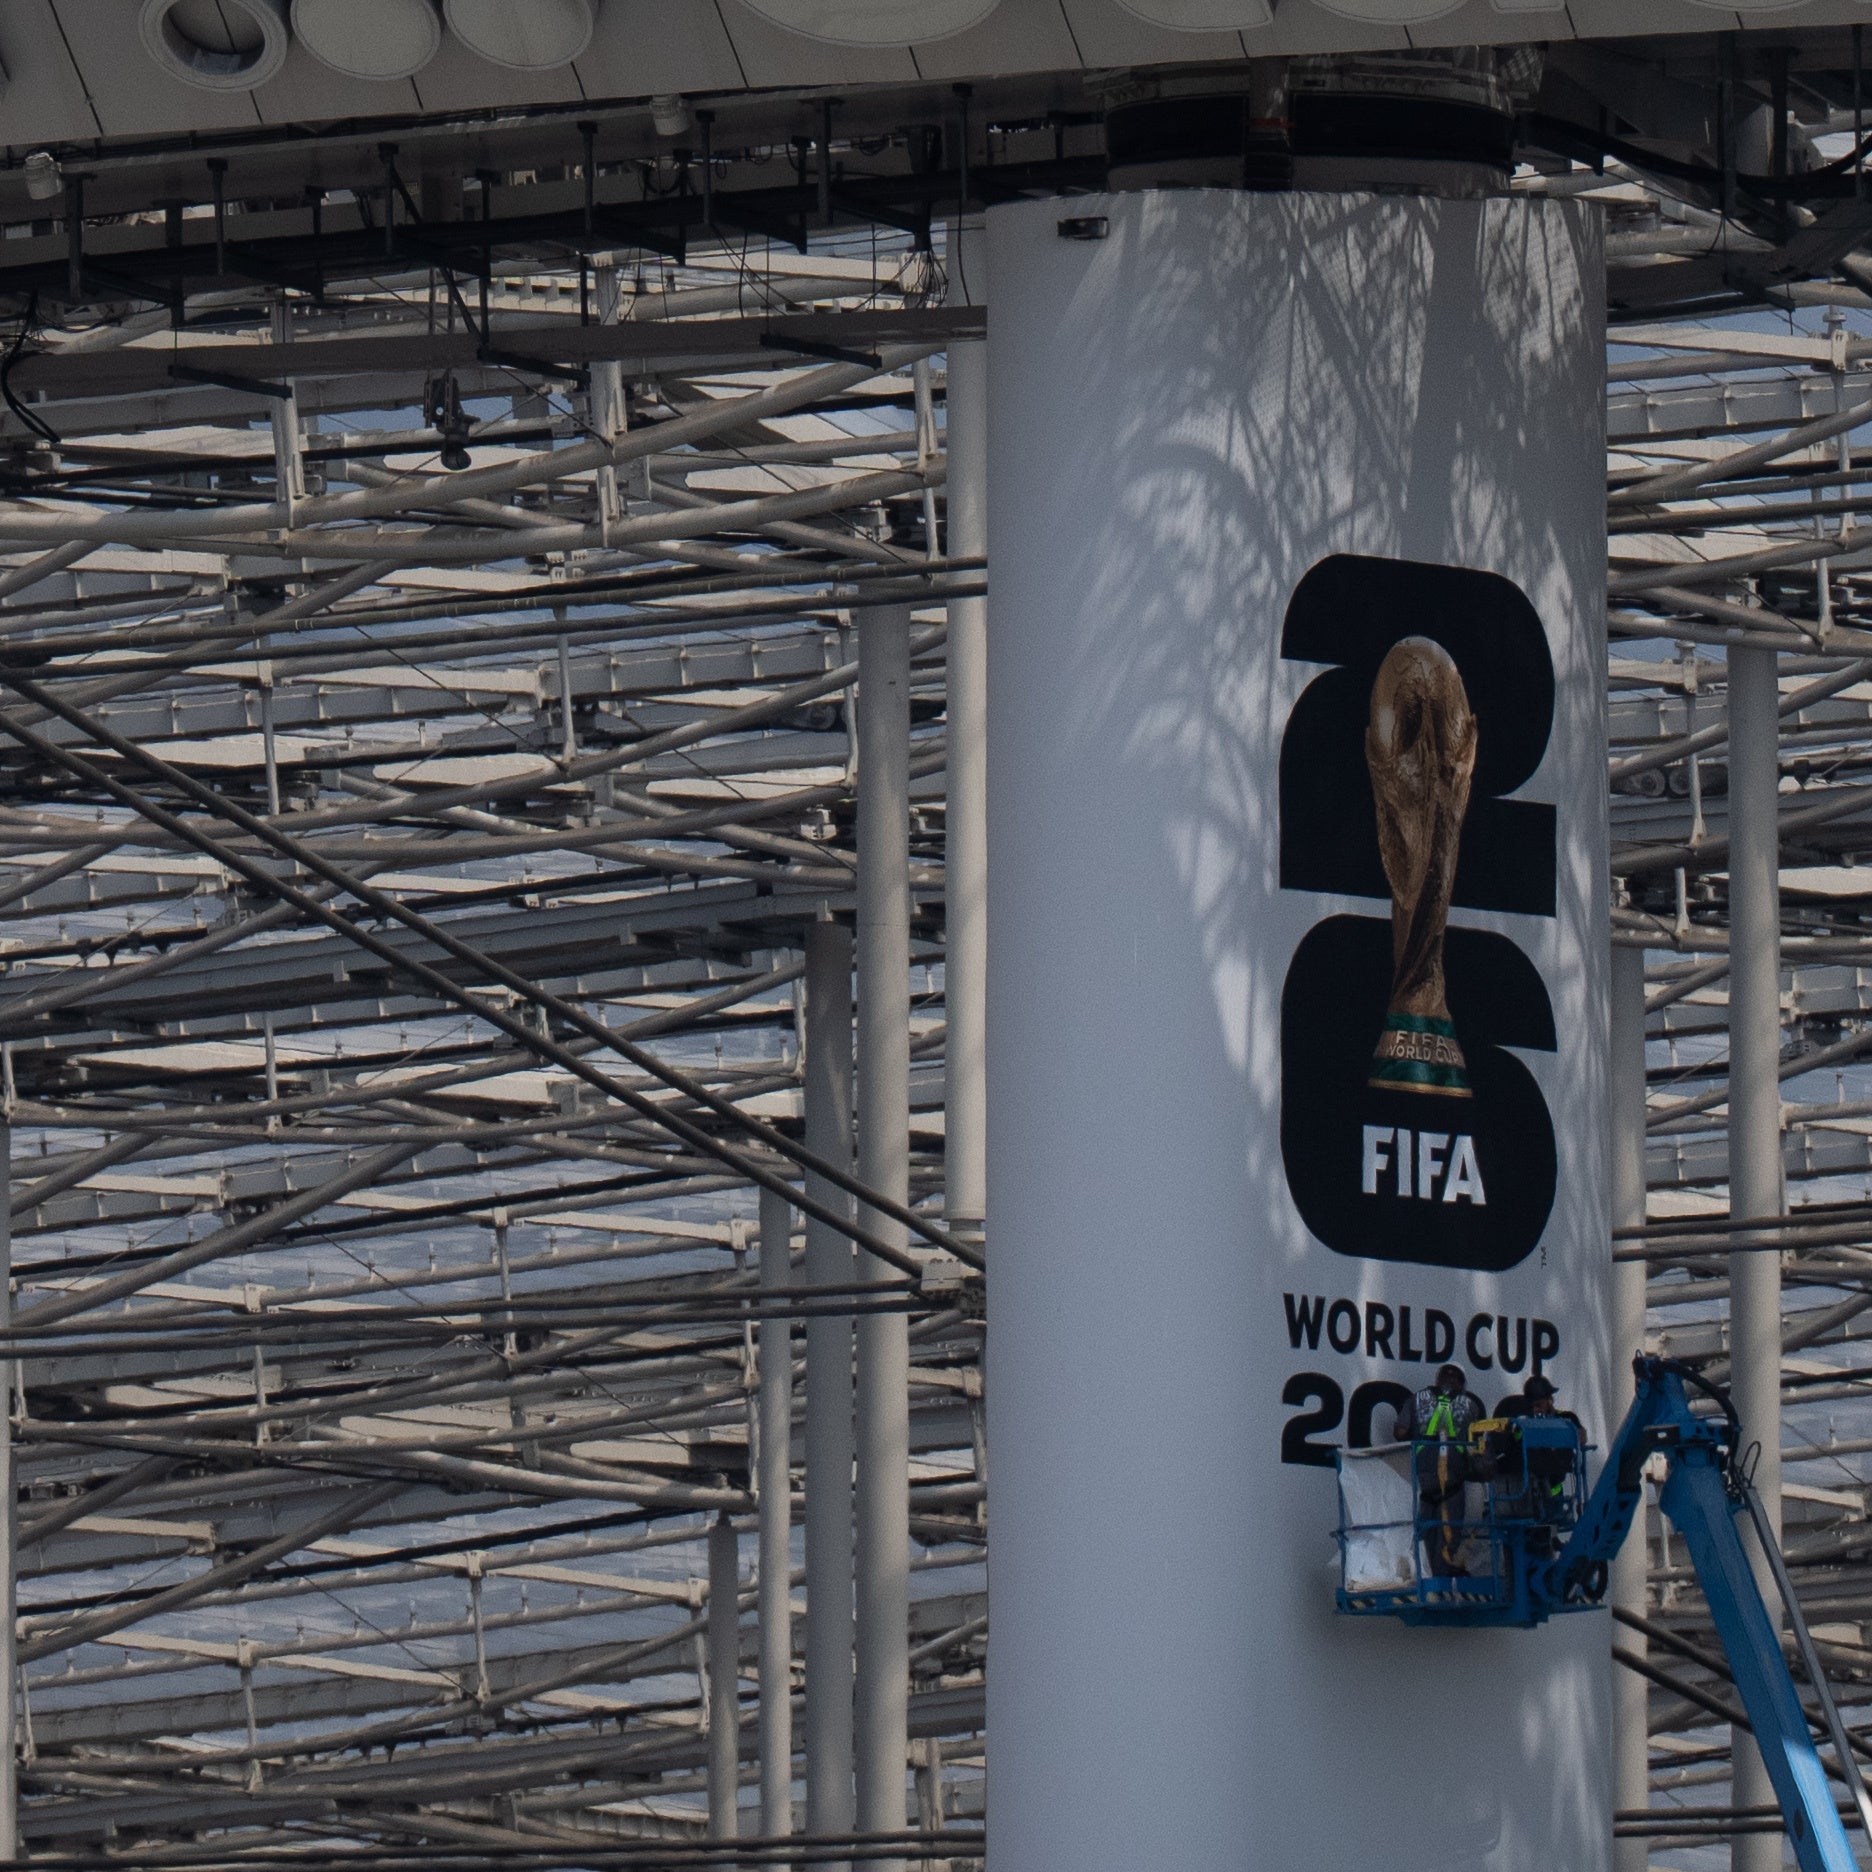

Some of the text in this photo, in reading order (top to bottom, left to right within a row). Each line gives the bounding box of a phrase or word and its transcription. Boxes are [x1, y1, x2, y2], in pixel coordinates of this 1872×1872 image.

[1396, 1030, 1449, 1048] FIFA
[1435, 1049, 1460, 1064] CUP
[1362, 1124, 1487, 1206] FIFA
[1283, 1292, 1560, 1376] WORLD CUP
[1280, 1371, 1530, 1468] 20
